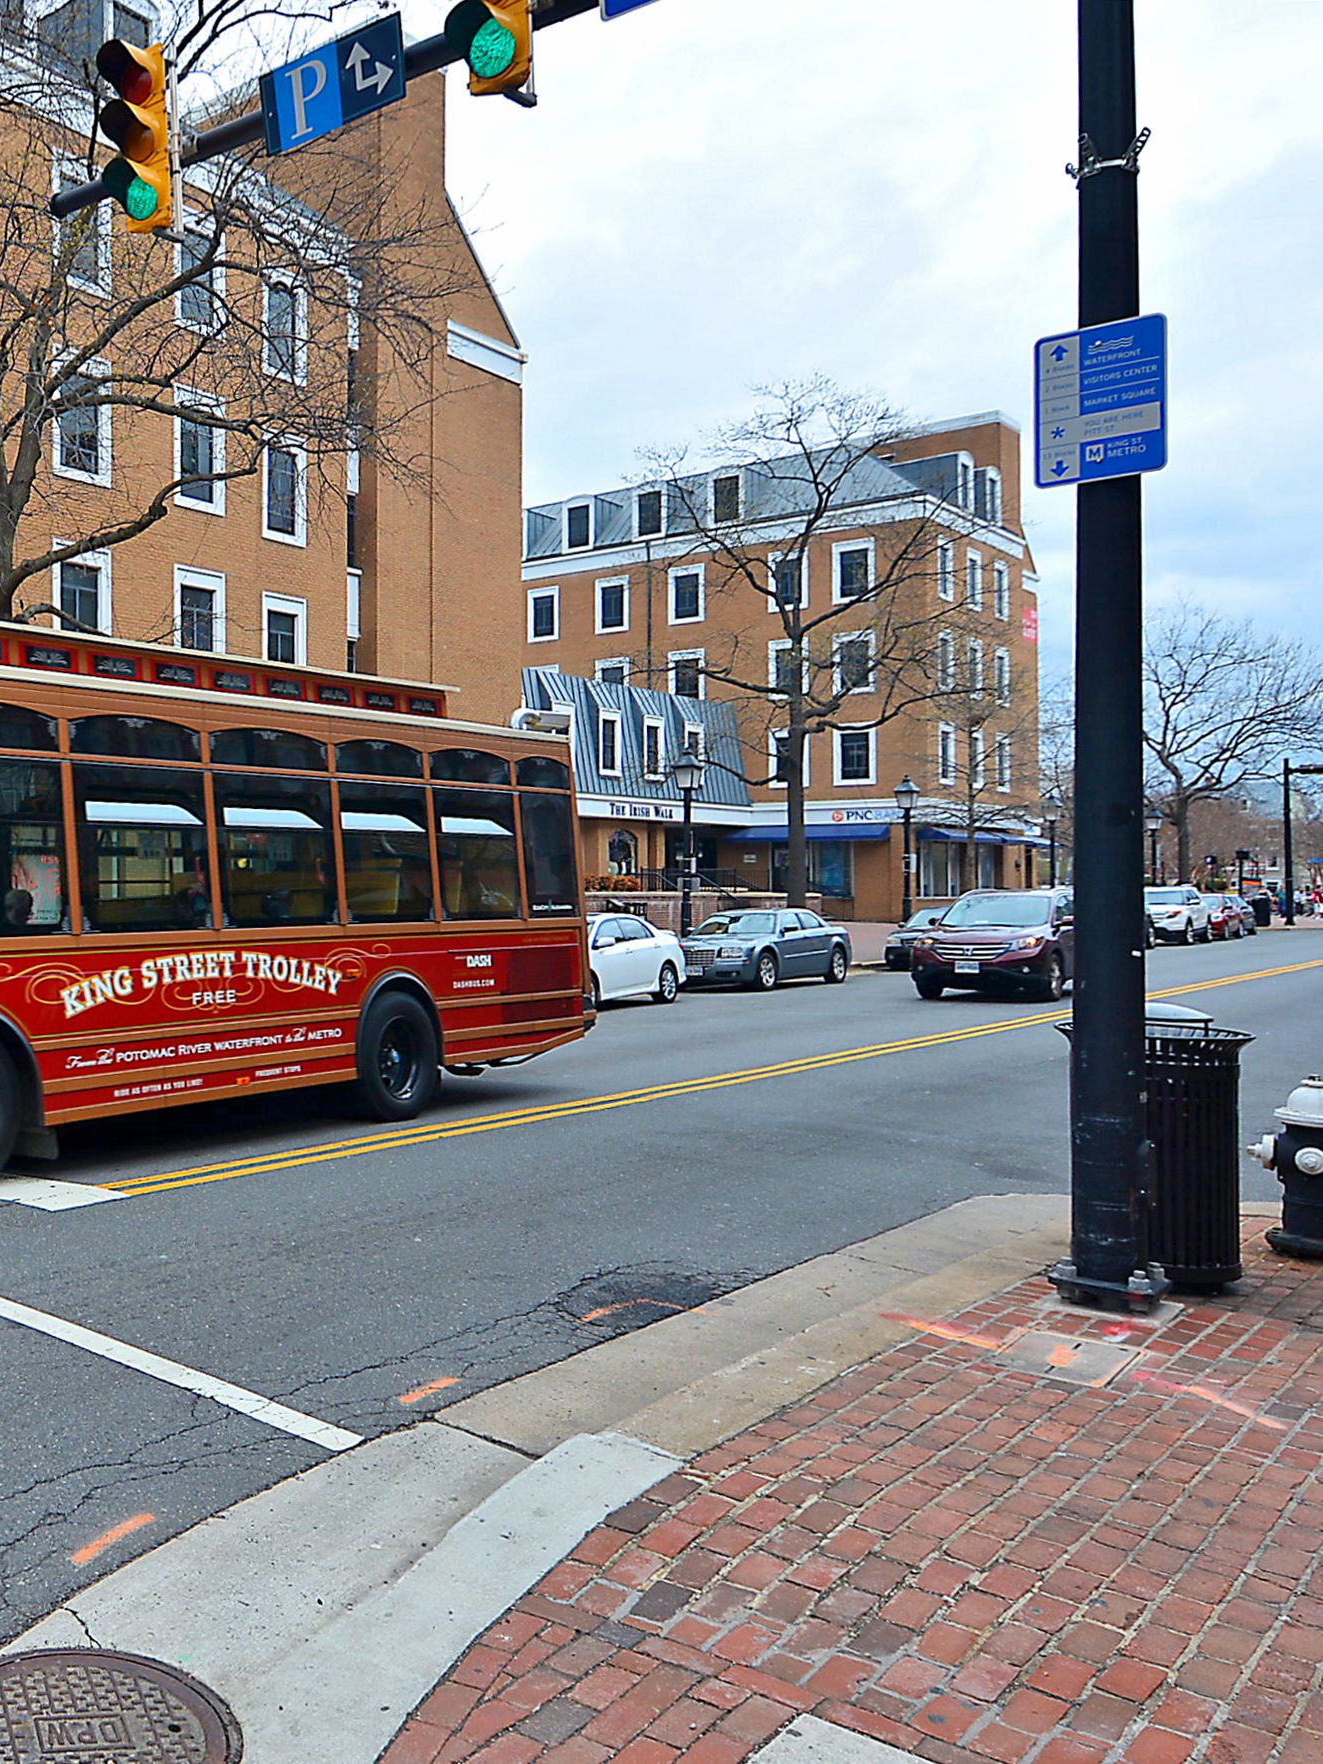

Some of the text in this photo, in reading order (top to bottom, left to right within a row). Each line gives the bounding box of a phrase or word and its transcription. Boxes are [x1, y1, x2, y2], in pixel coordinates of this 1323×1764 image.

[285, 60, 326, 138] P
[1084, 348, 1141, 366] WATERFRONT
[1084, 364, 1157, 385] VISITORS CENTER
[1084, 386, 1156, 407] MARKET SQUARE
[1084, 410, 1144, 427] YOU ARE HERE
[1107, 440, 1129, 449] KING
[1107, 445, 1147, 458] METRO
[609, 802, 674, 819] THE IRISH WALK
[846, 804, 873, 820] PNC
[466, 954, 492, 968] DASH
[62, 951, 342, 1018] KING STREET TROLLEY
[452, 978, 495, 989] DASHBUS.COM
[192, 989, 237, 1005] FREE
[116, 1046, 176, 1063] POTOMAC
[178, 1042, 212, 1056] RIVER
[213, 1034, 283, 1051] WATERFRONT
[308, 1028, 343, 1041] METRO
